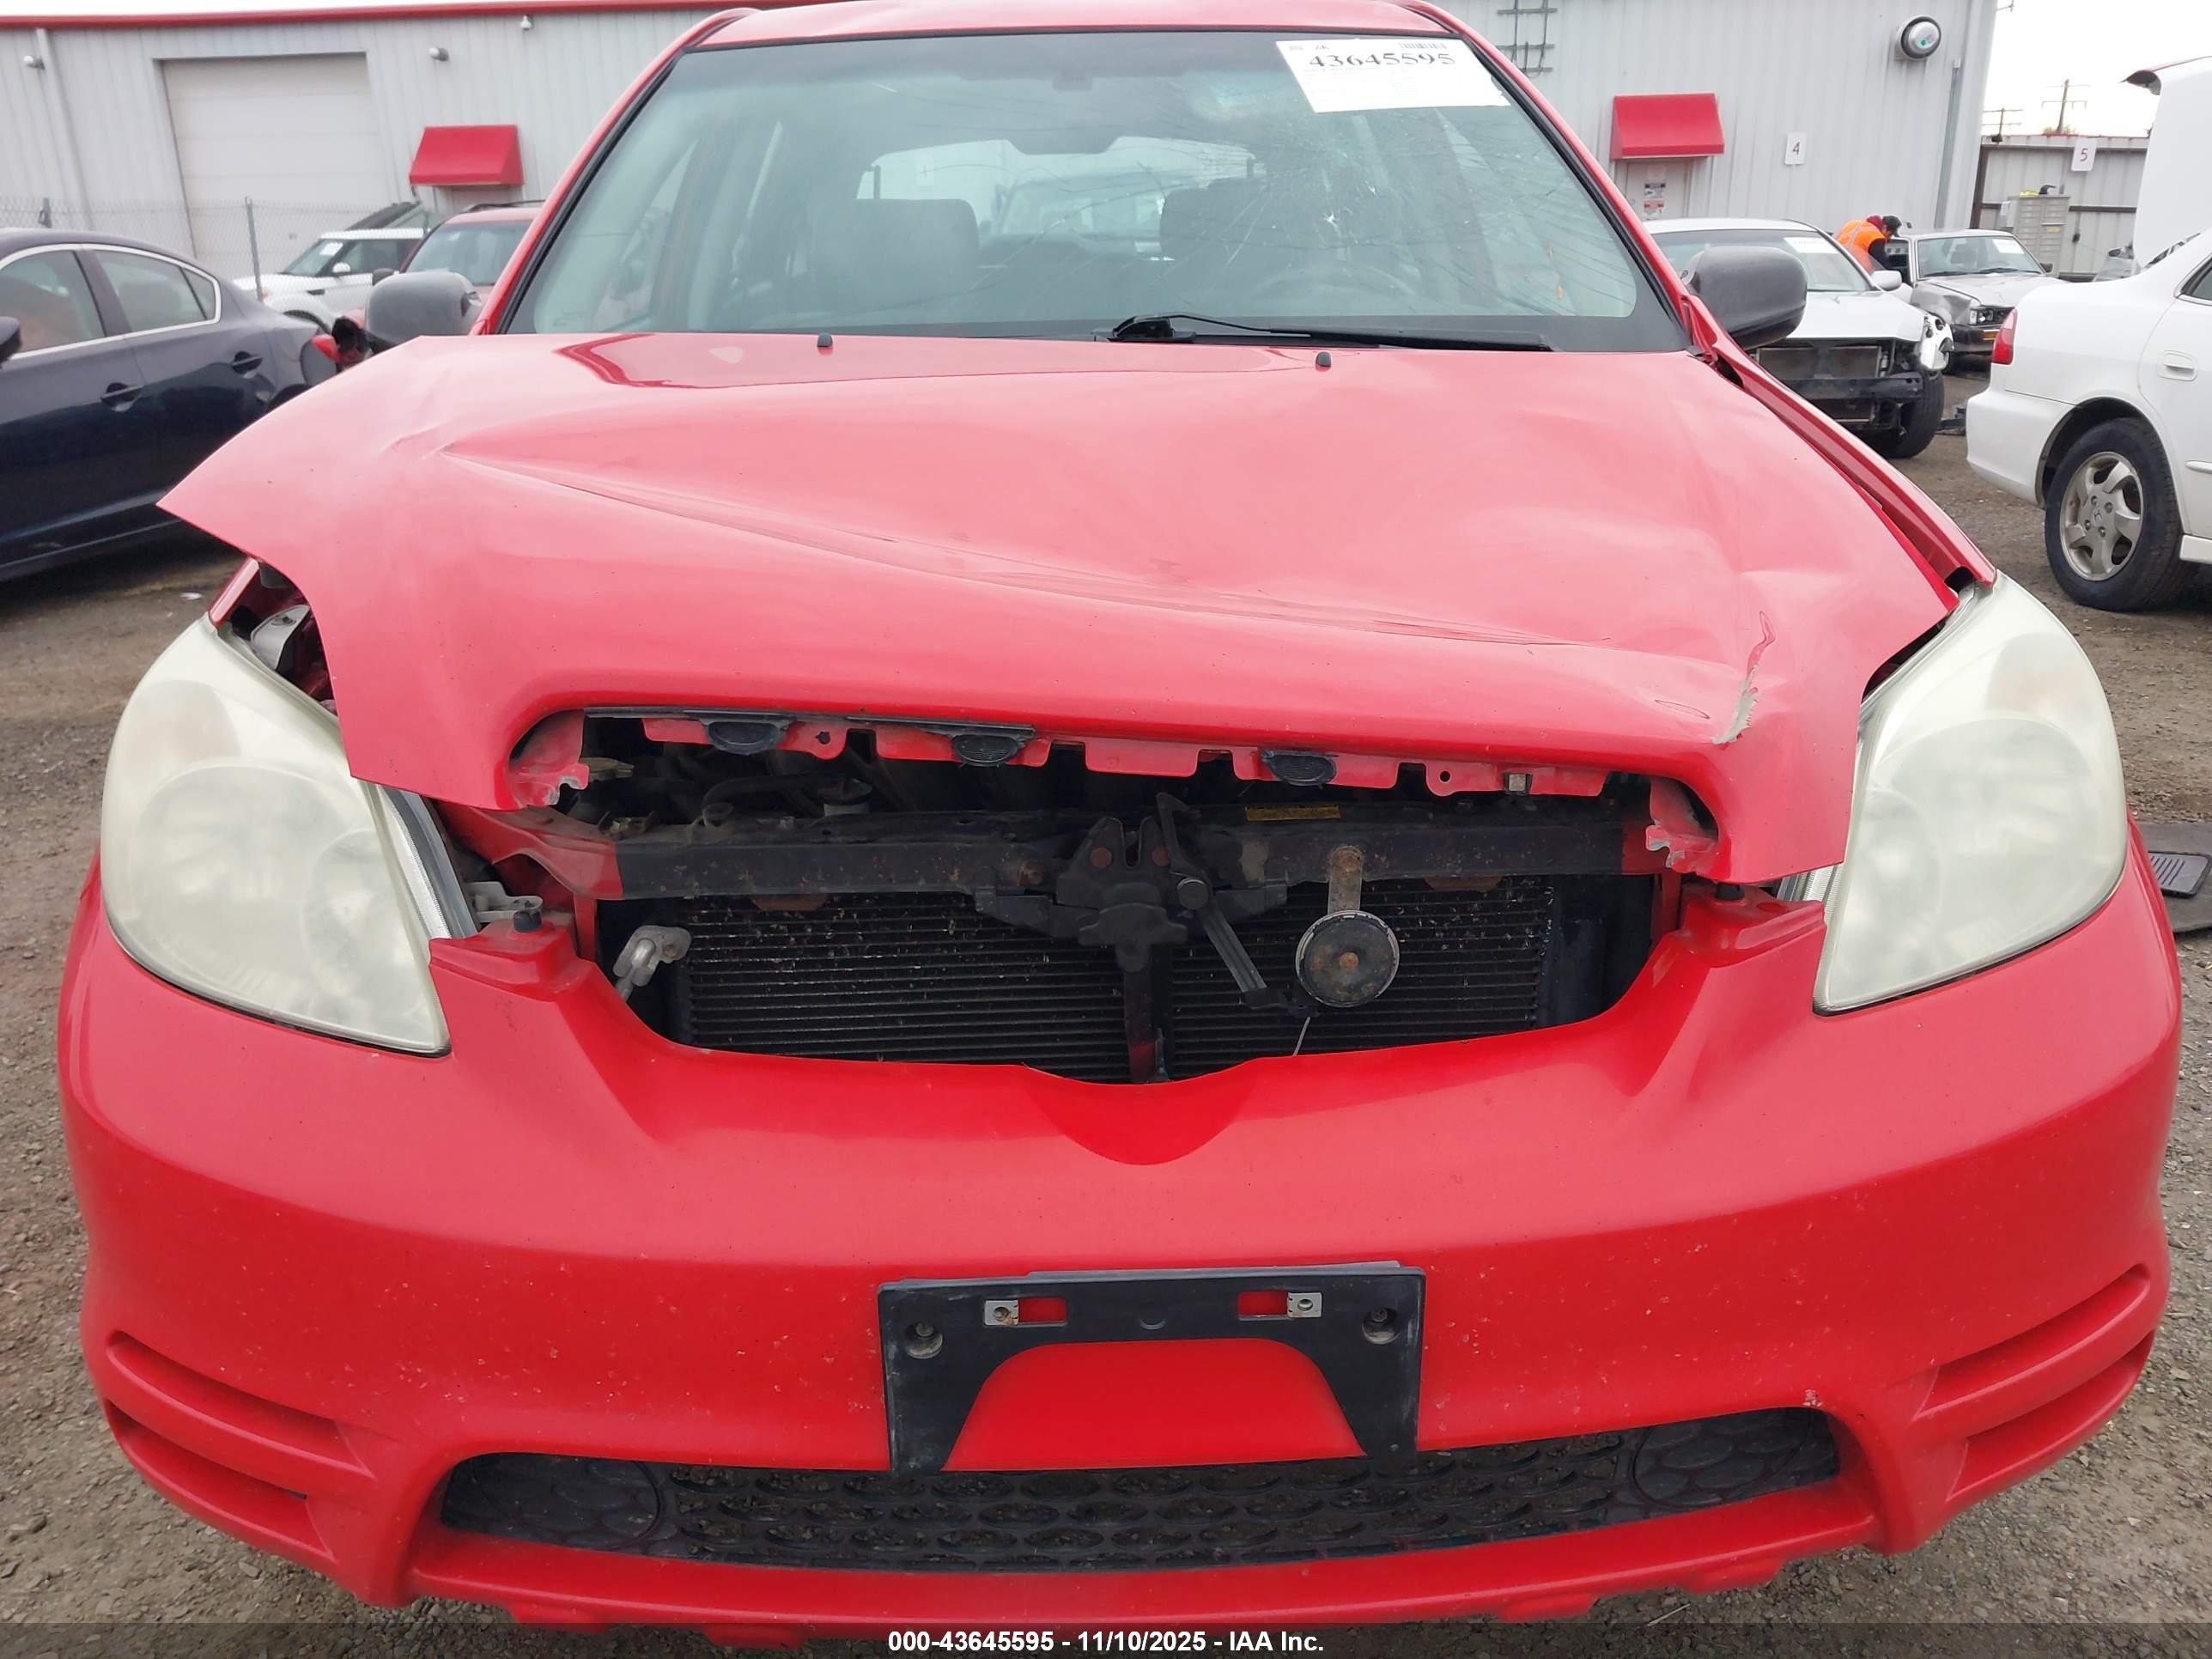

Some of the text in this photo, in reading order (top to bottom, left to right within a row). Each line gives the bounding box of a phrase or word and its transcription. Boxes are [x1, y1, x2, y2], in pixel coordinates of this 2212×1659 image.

[1309, 52, 1455, 67] 43645595
[1792, 141, 1801, 155] 4
[2079, 148, 2088, 161] 5
